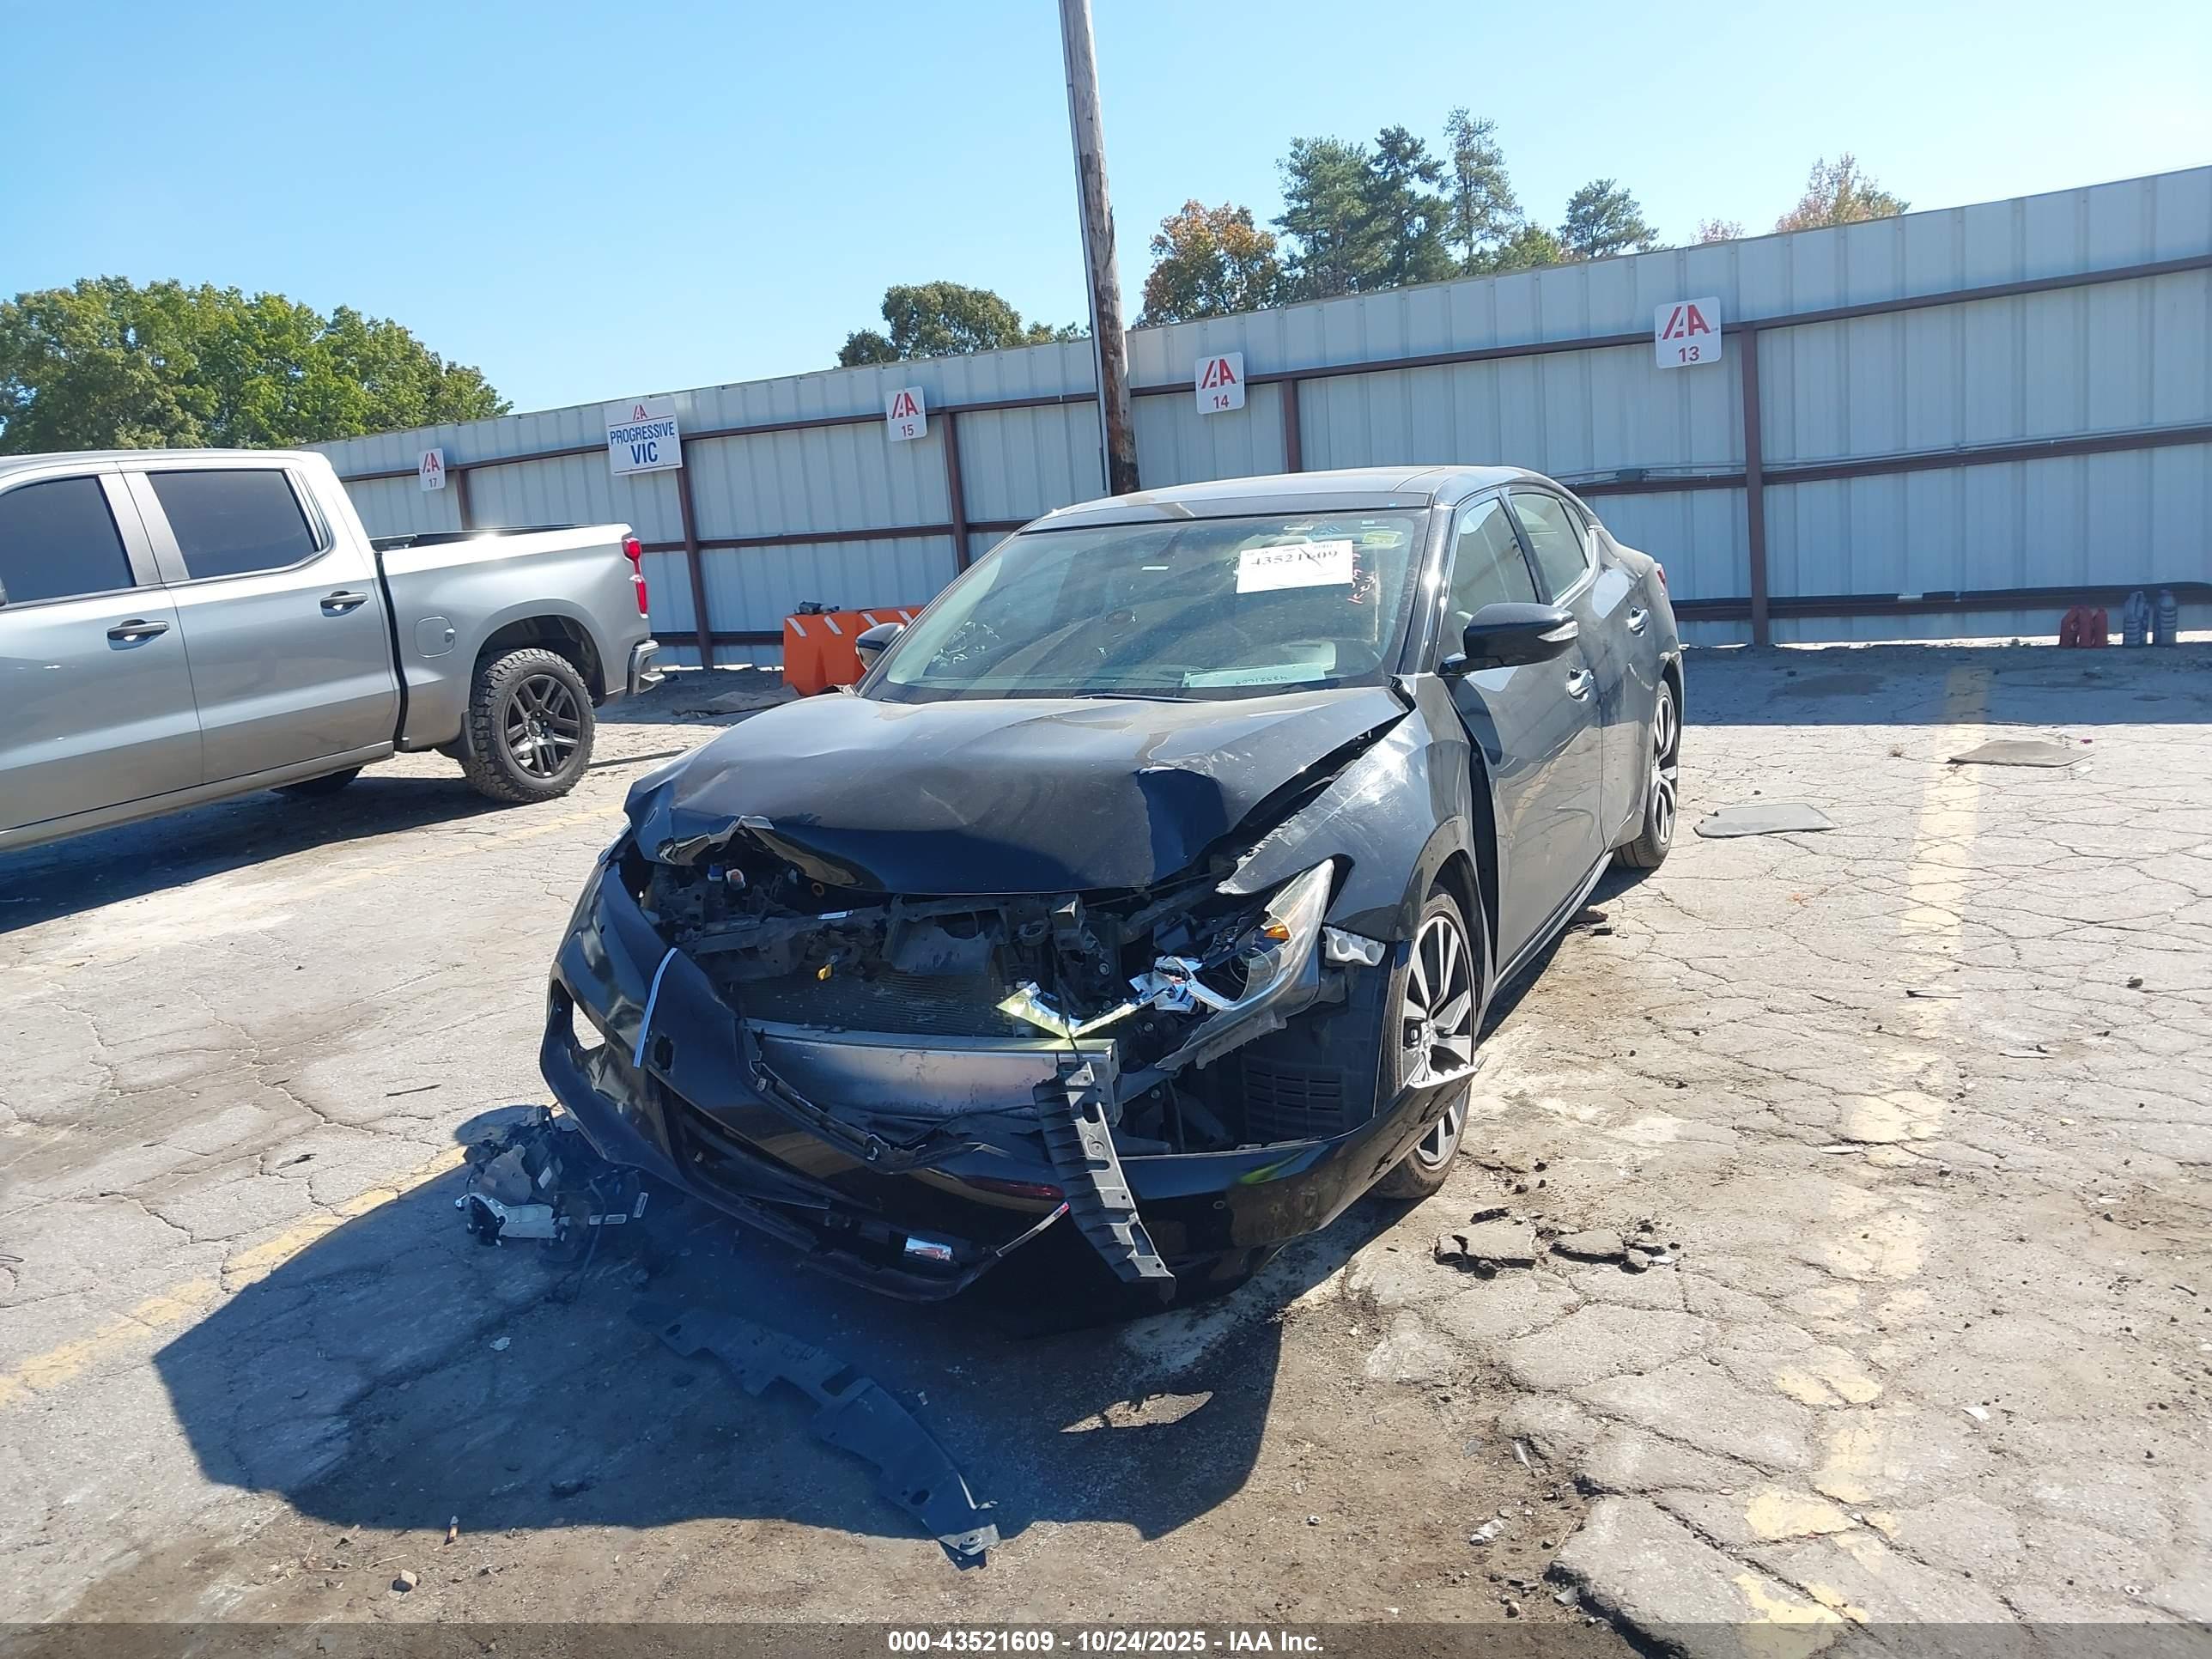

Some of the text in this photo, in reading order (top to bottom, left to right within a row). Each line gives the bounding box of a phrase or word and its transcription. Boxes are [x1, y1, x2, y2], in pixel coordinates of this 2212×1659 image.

[1678, 346, 1700, 362] 13
[1212, 394, 1230, 410] 14
[609, 421, 675, 445] PROGRESSIVE
[901, 423, 915, 437] 15
[629, 441, 659, 465] VIC
[428, 477, 437, 489] 17
